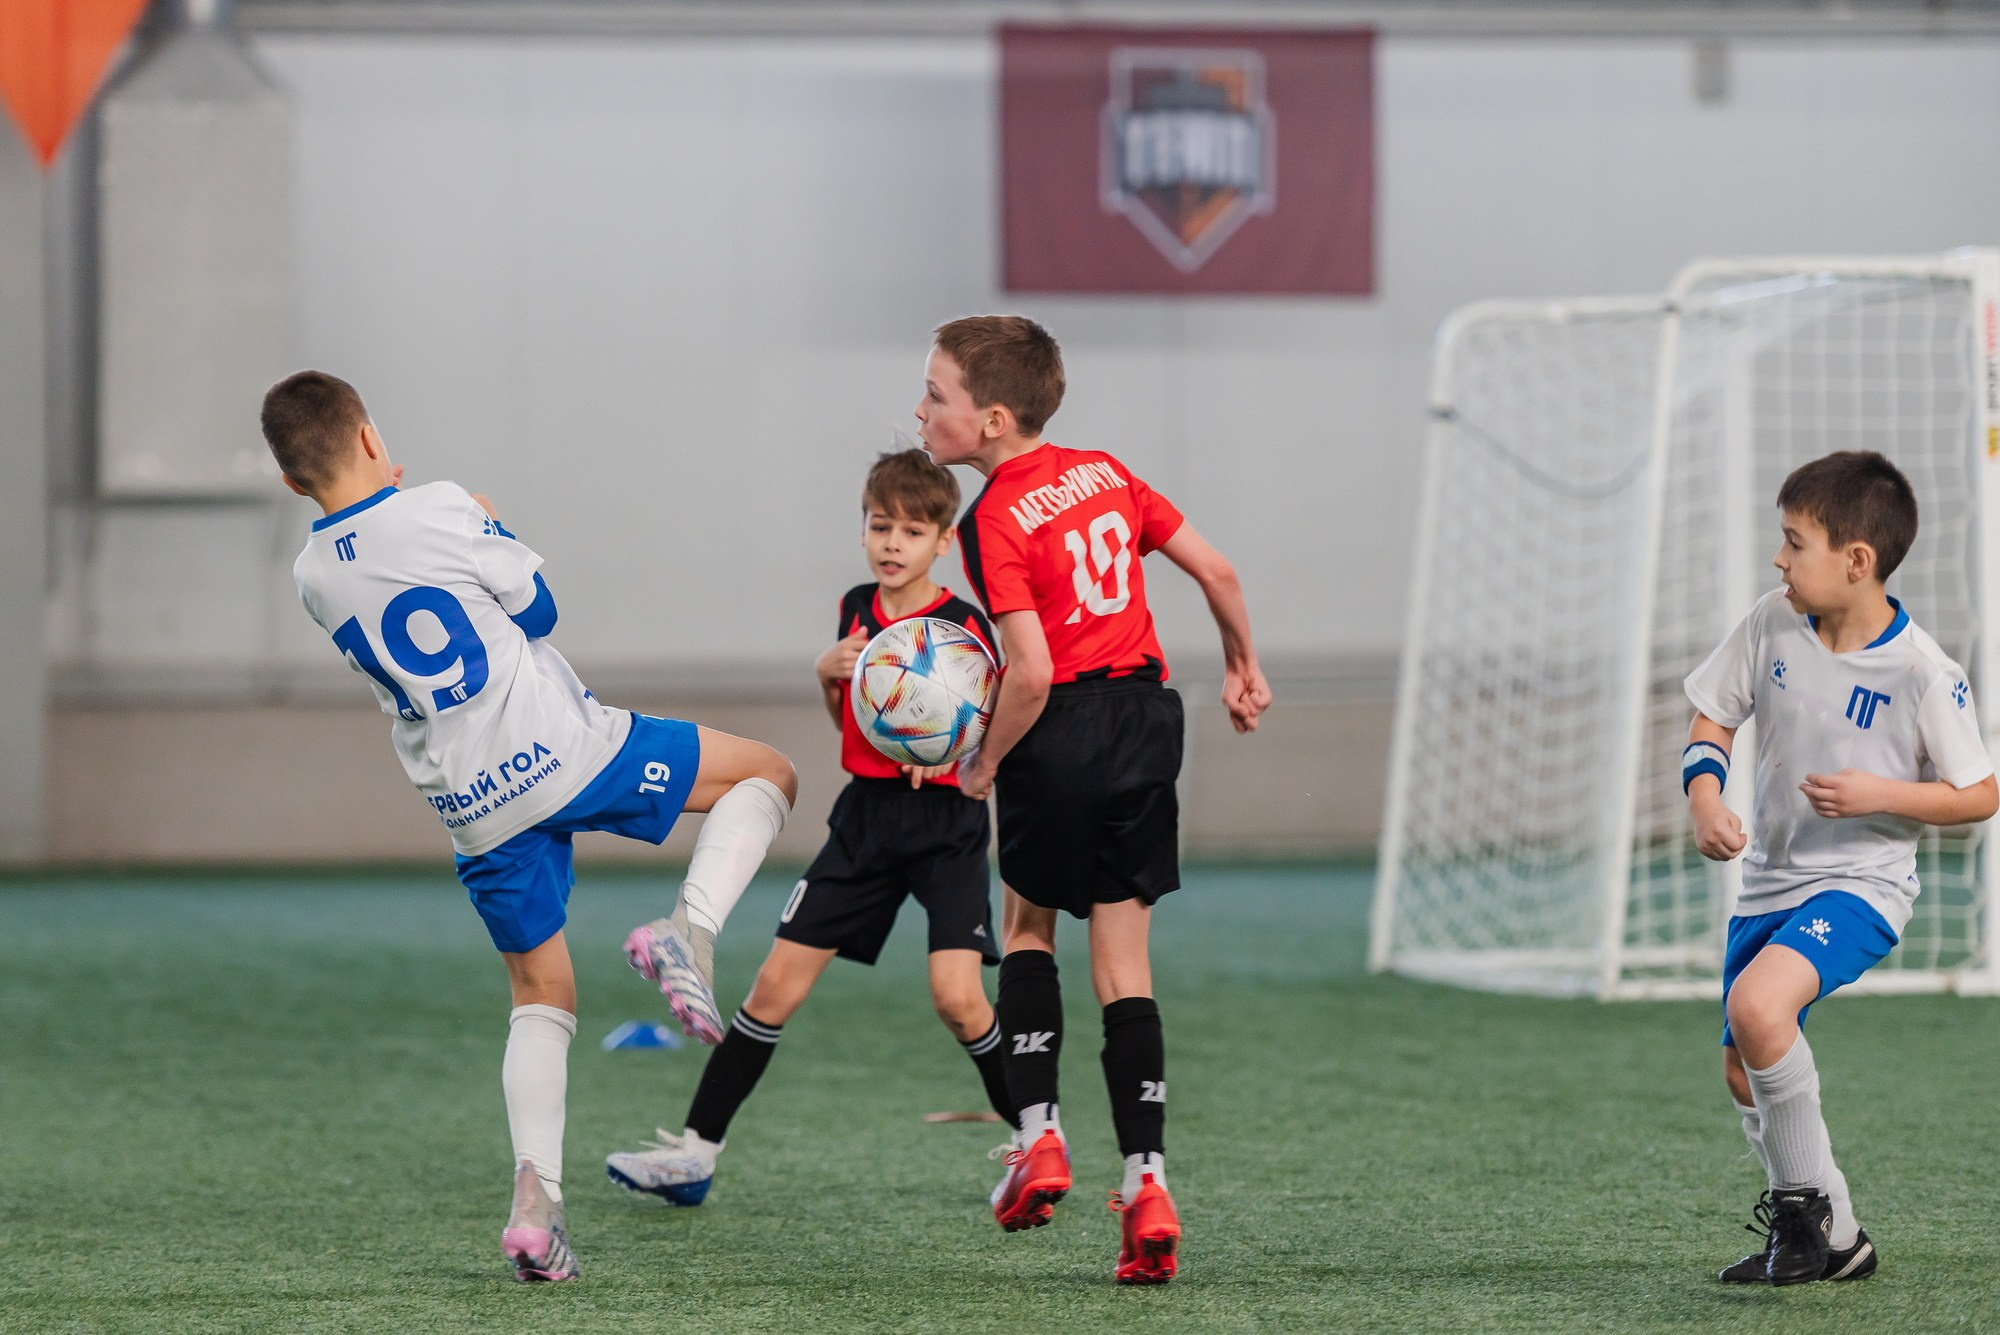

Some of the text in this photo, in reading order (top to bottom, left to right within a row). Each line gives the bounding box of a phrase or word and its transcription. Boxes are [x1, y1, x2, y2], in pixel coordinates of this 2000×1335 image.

[334, 531, 357, 562] ПГ
[1063, 510, 1132, 625] 10
[332, 585, 489, 722] 19
[450, 681, 468, 701] ПГ
[1845, 684, 1892, 730] ПГ
[498, 741, 552, 783] ГОЛ
[638, 761, 671, 794] 19
[441, 758, 562, 829] ОЛЬНАЯ АКАДЕМИЯ
[1012, 1031, 1055, 1055] 2K
